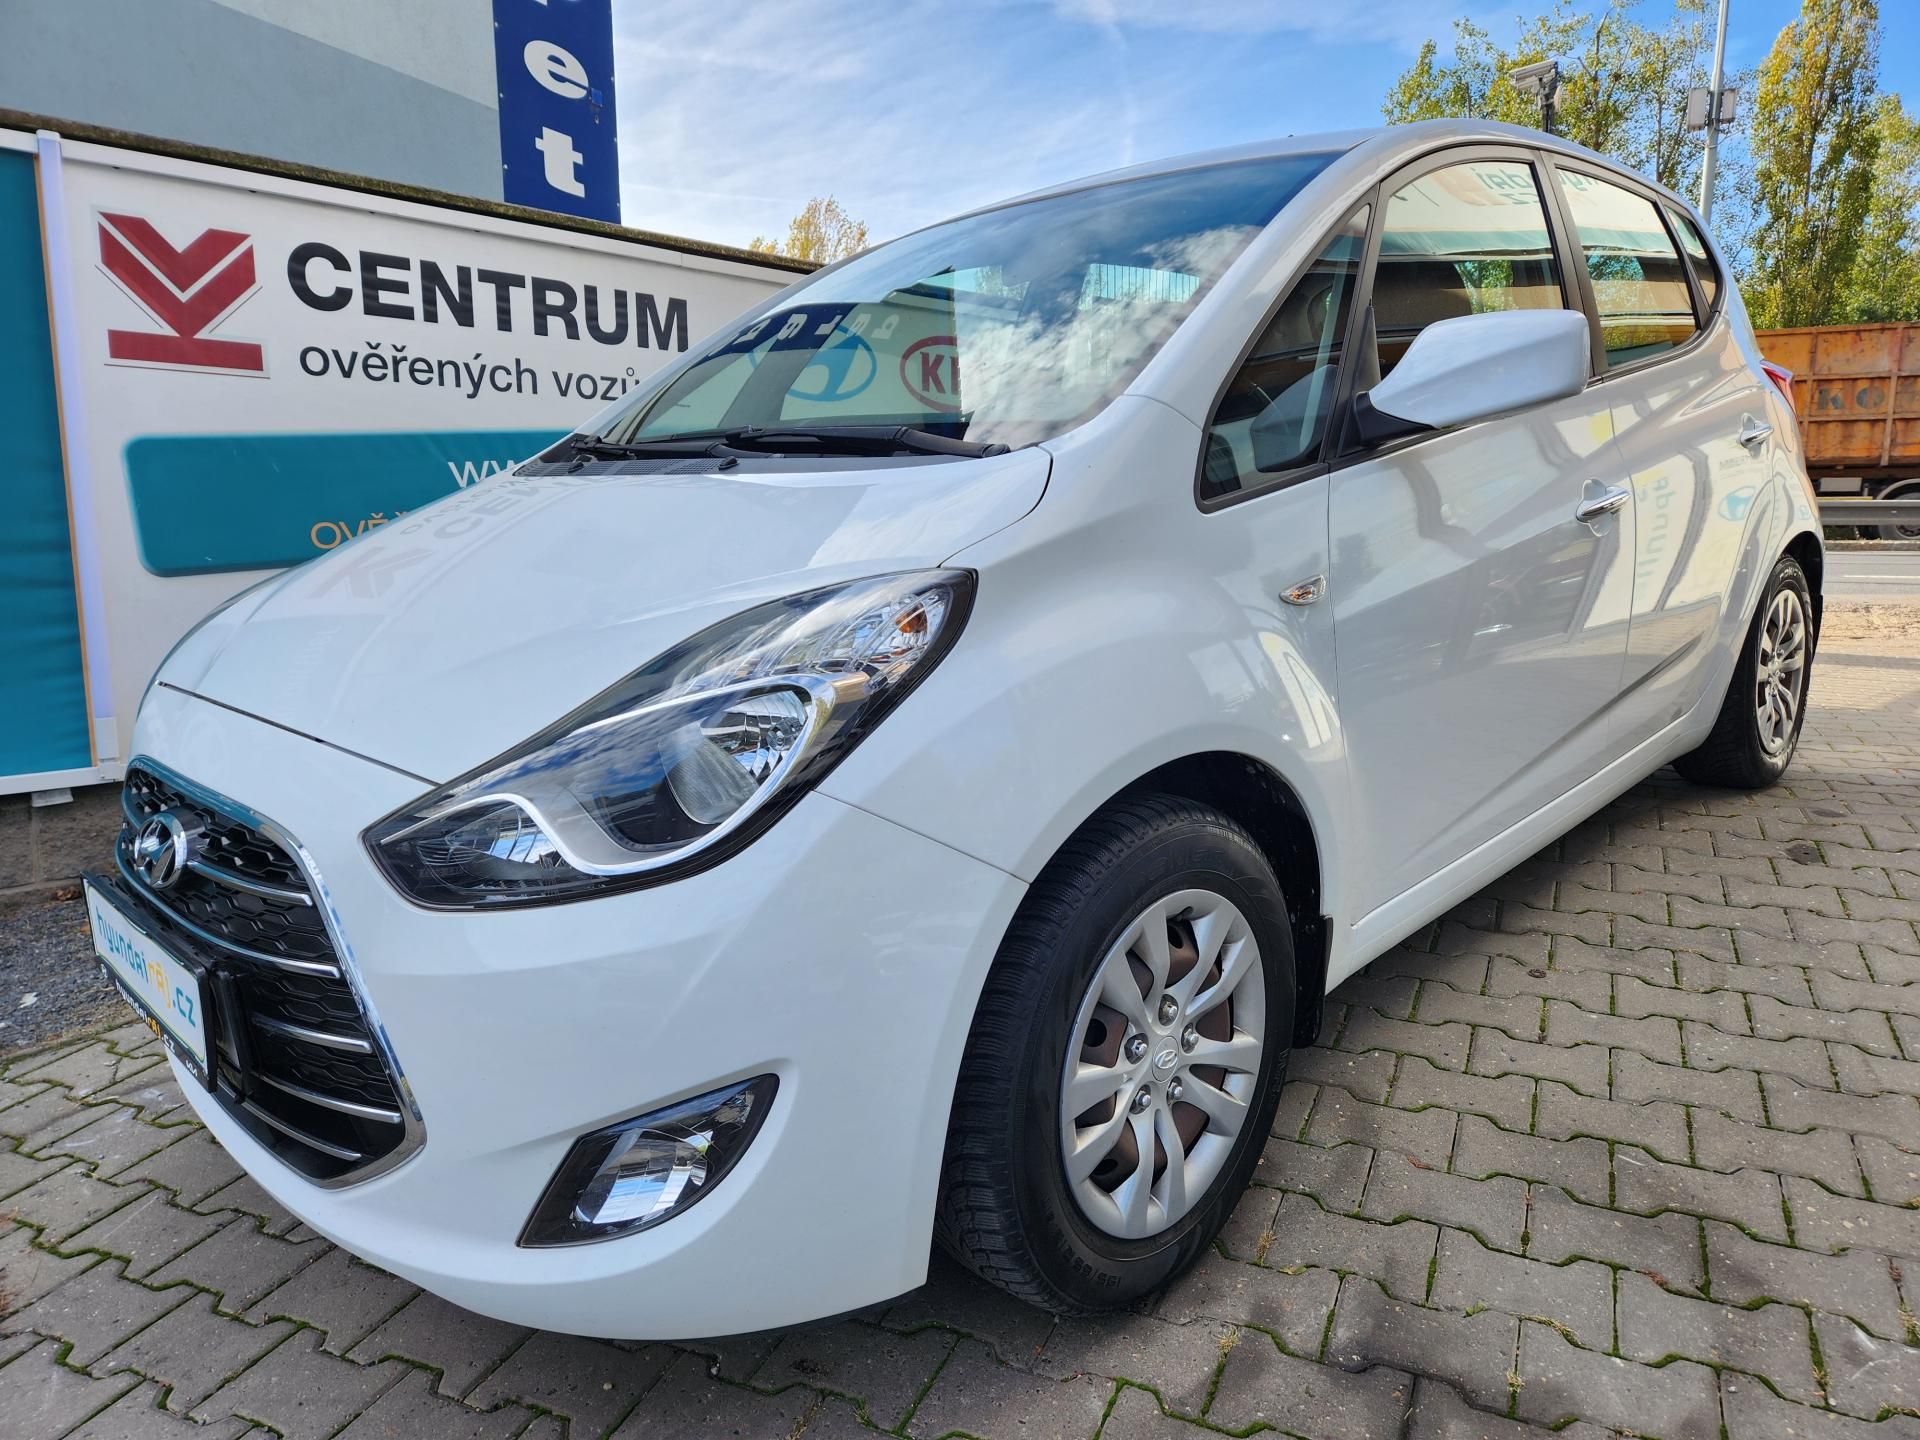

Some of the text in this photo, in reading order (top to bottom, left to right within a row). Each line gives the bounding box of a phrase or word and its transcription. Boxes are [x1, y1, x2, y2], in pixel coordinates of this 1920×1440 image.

[523, 0, 588, 199] et
[287, 242, 689, 353] CENTRUM
[299, 341, 539, 399] ověřených
[920, 351, 961, 395] KI
[310, 511, 409, 549] OVĚ
